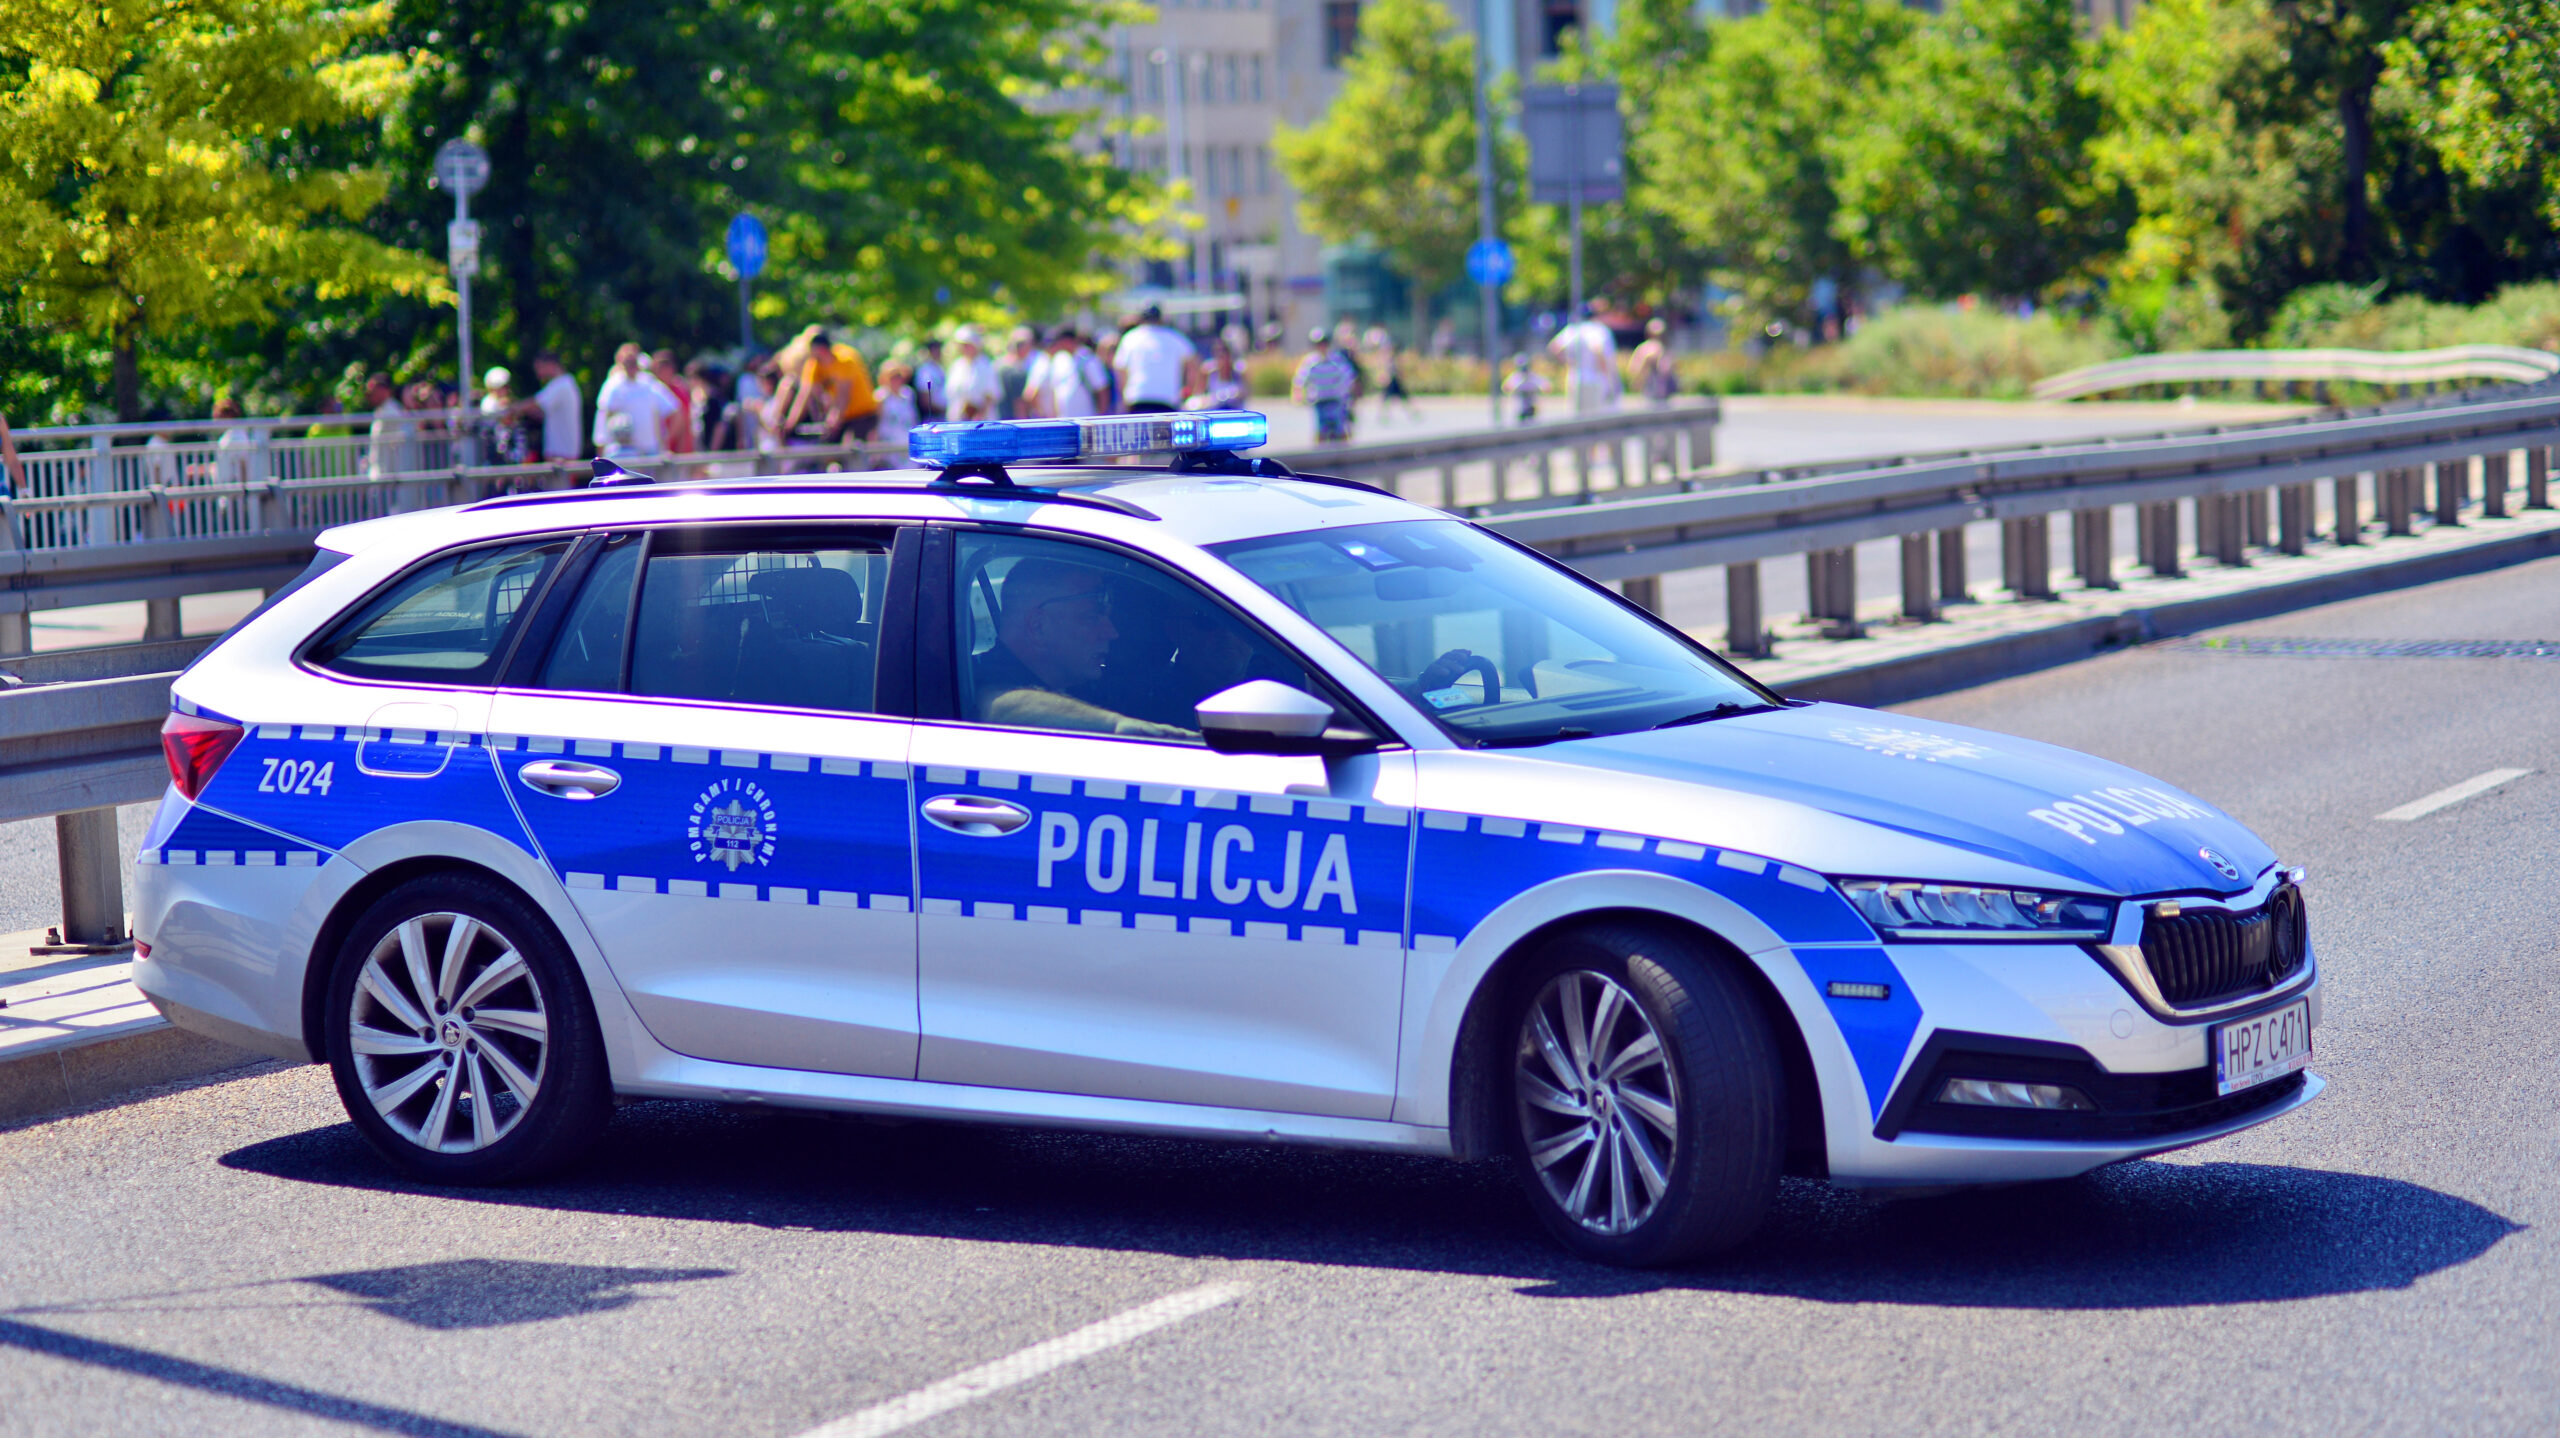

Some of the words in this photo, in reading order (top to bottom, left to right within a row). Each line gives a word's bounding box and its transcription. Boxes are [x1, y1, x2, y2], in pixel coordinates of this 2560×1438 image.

[258, 758, 334, 796] Z024
[687, 778, 729, 863] POMAGAMY
[735, 778, 742, 791] I
[745, 782, 778, 867] CHRONIMY
[717, 815, 750, 826] POLICJA
[726, 840, 739, 848] 112
[2027, 787, 2215, 845] POLICJA
[1037, 810, 1358, 915] POLICJA
[2229, 1022, 2263, 1076] HPZ
[2269, 1007, 2304, 1061] C471
